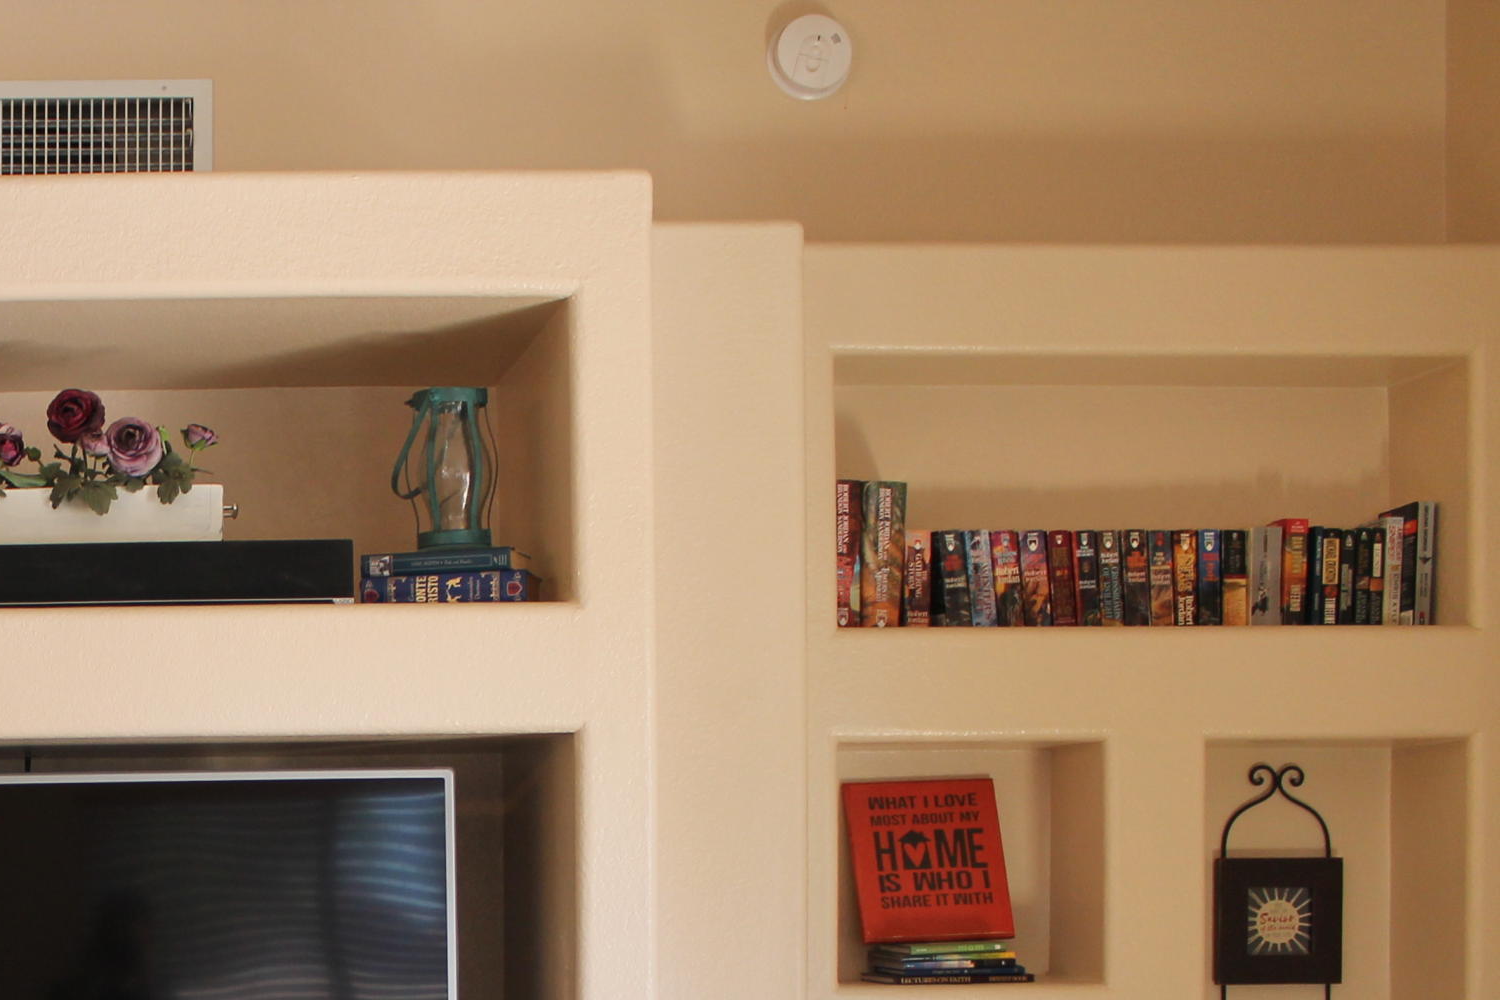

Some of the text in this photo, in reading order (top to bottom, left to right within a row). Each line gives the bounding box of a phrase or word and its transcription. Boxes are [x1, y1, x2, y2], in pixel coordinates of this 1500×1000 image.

[884, 488, 892, 518] ROBERT
[884, 521, 892, 550] JORDAN
[416, 576, 426, 602] ONTE
[428, 576, 439, 603] RISTO
[1178, 596, 1186, 625] Jordan
[1186, 595, 1194, 625] Robert
[1324, 598, 1336, 624] TIMELINE
[868, 793, 978, 810] WHAT I LOVE
[870, 811, 980, 826] MOST ABOUT MY
[879, 871, 991, 893] IS WHO I
[881, 892, 993, 910] SHARE IT WITH
